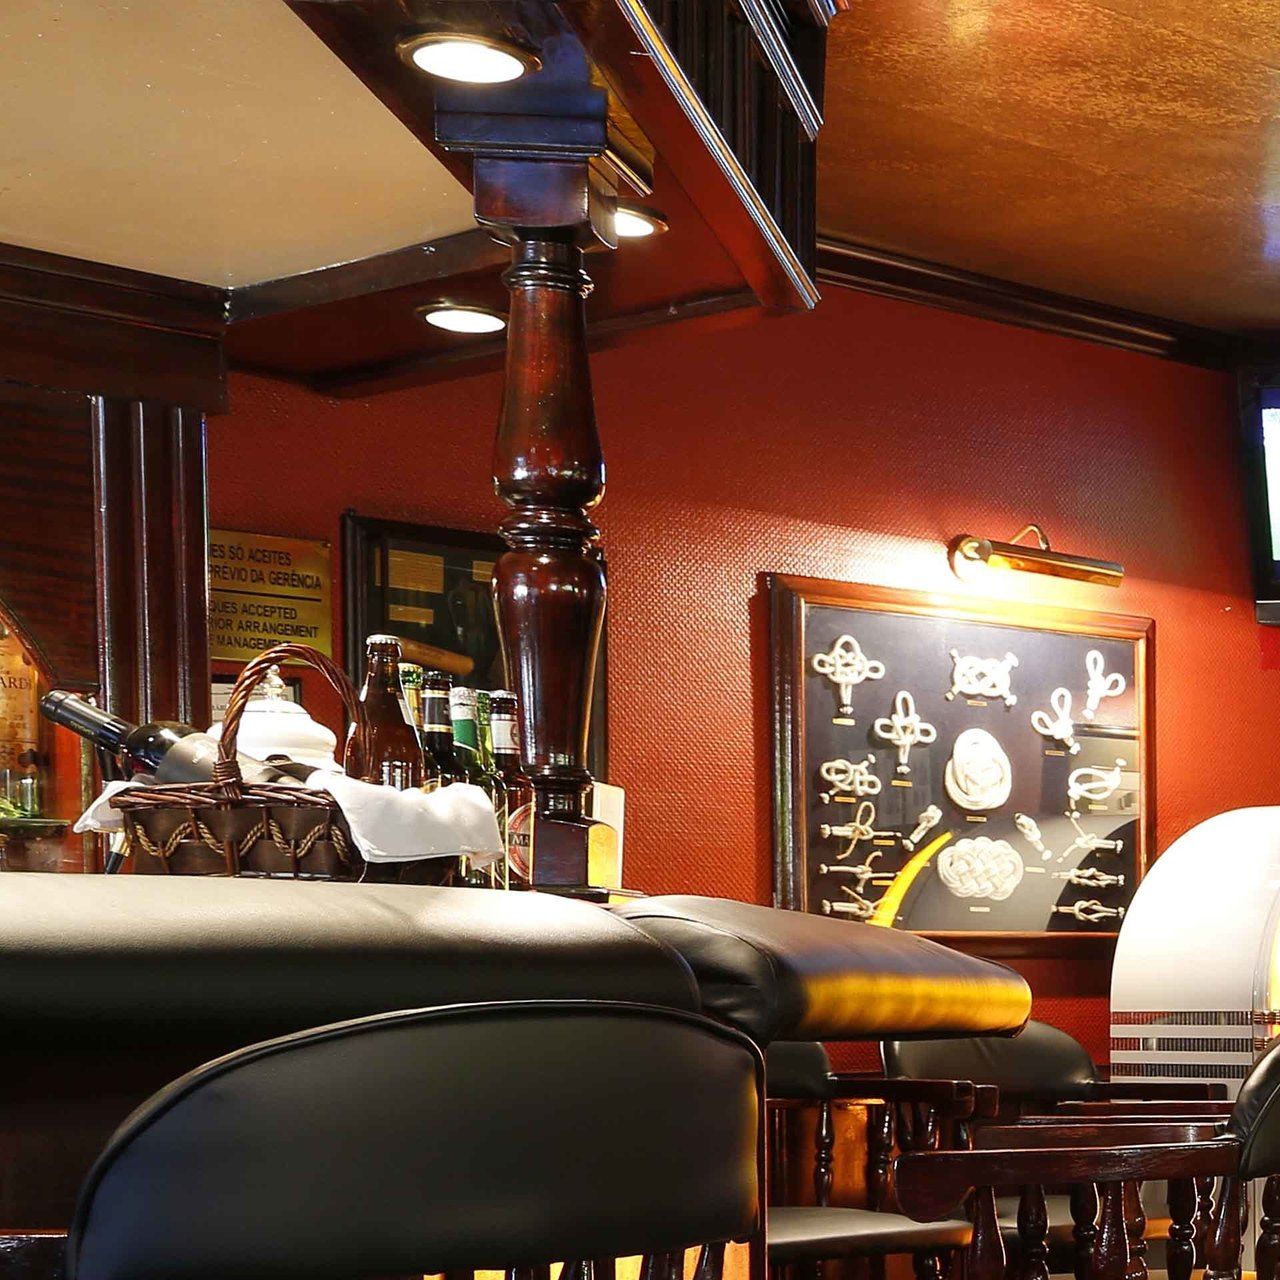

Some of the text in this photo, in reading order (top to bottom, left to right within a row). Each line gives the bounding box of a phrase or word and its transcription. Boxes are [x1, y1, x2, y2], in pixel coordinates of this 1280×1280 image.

[248, 549, 291, 566] ACEITES
[251, 570, 265, 583] DA
[269, 570, 322, 589] GERÊNCIA
[241, 603, 297, 619] ACCEPTED
[238, 620, 319, 638] ARRANGEMENT
